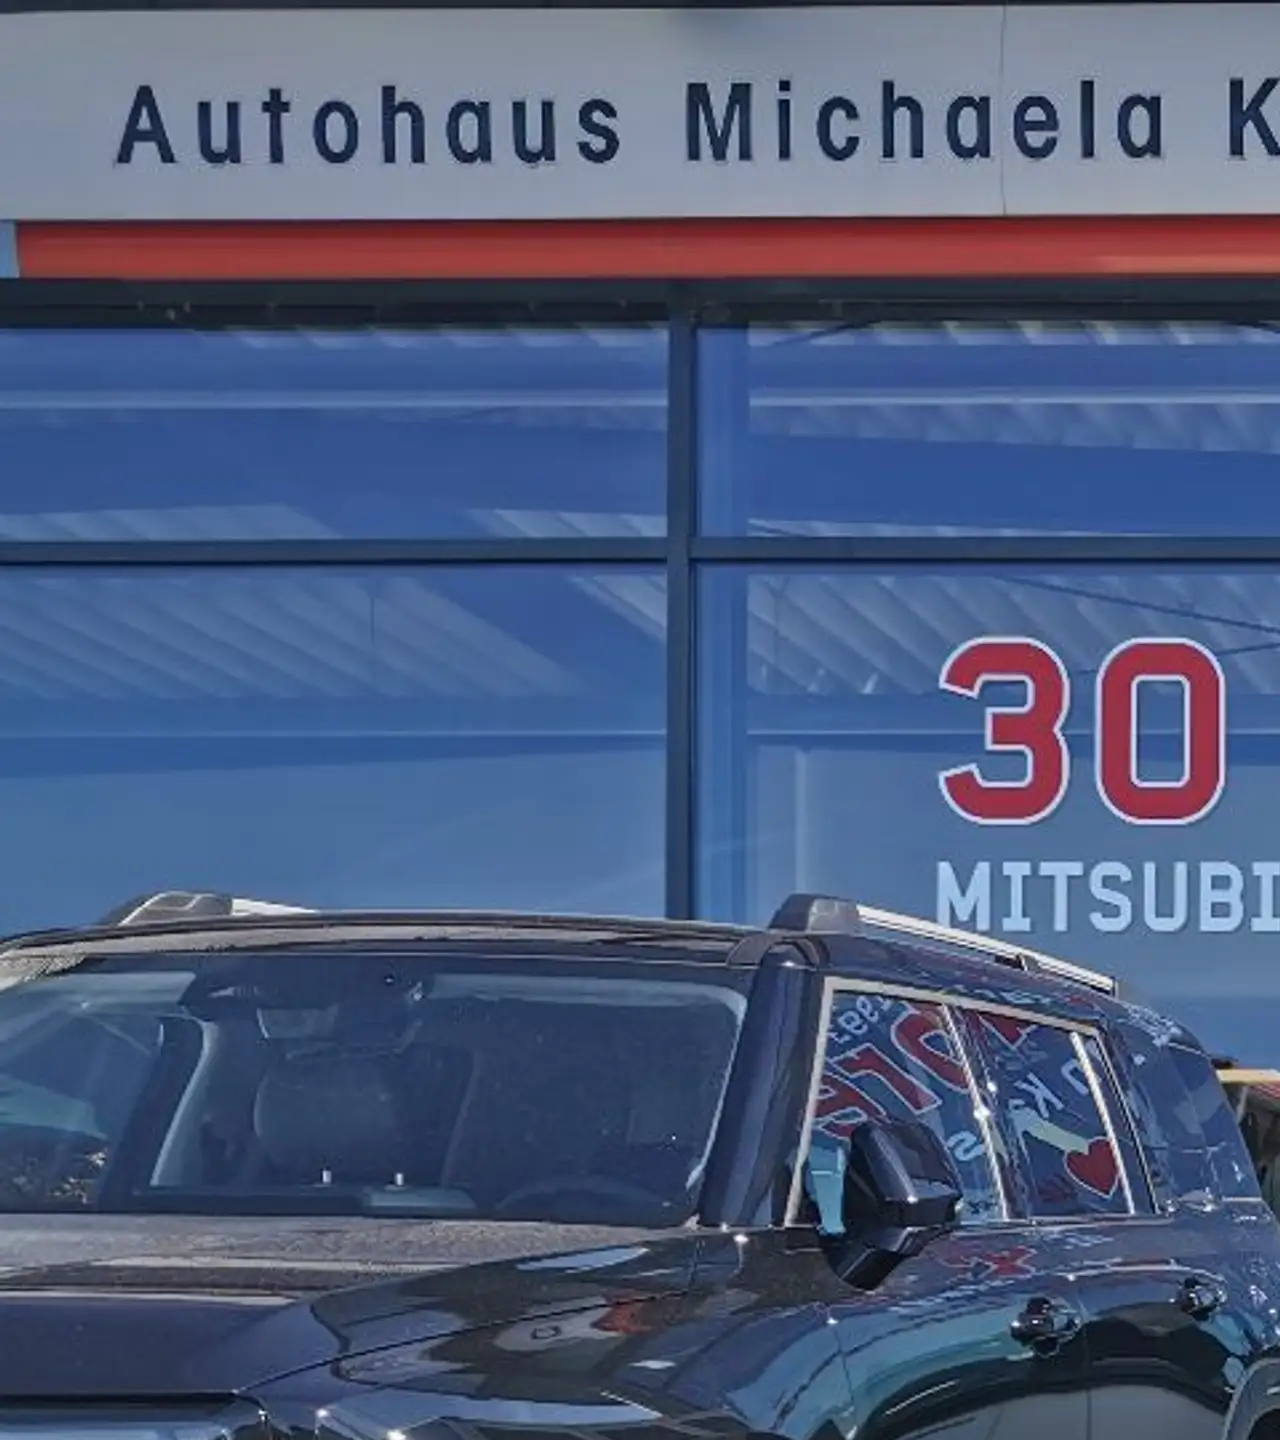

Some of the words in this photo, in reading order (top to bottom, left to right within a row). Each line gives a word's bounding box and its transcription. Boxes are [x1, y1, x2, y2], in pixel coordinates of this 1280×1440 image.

[115, 84, 621, 165] Autohaus
[687, 79, 1164, 163] Michaela
[938, 637, 1226, 824] 30
